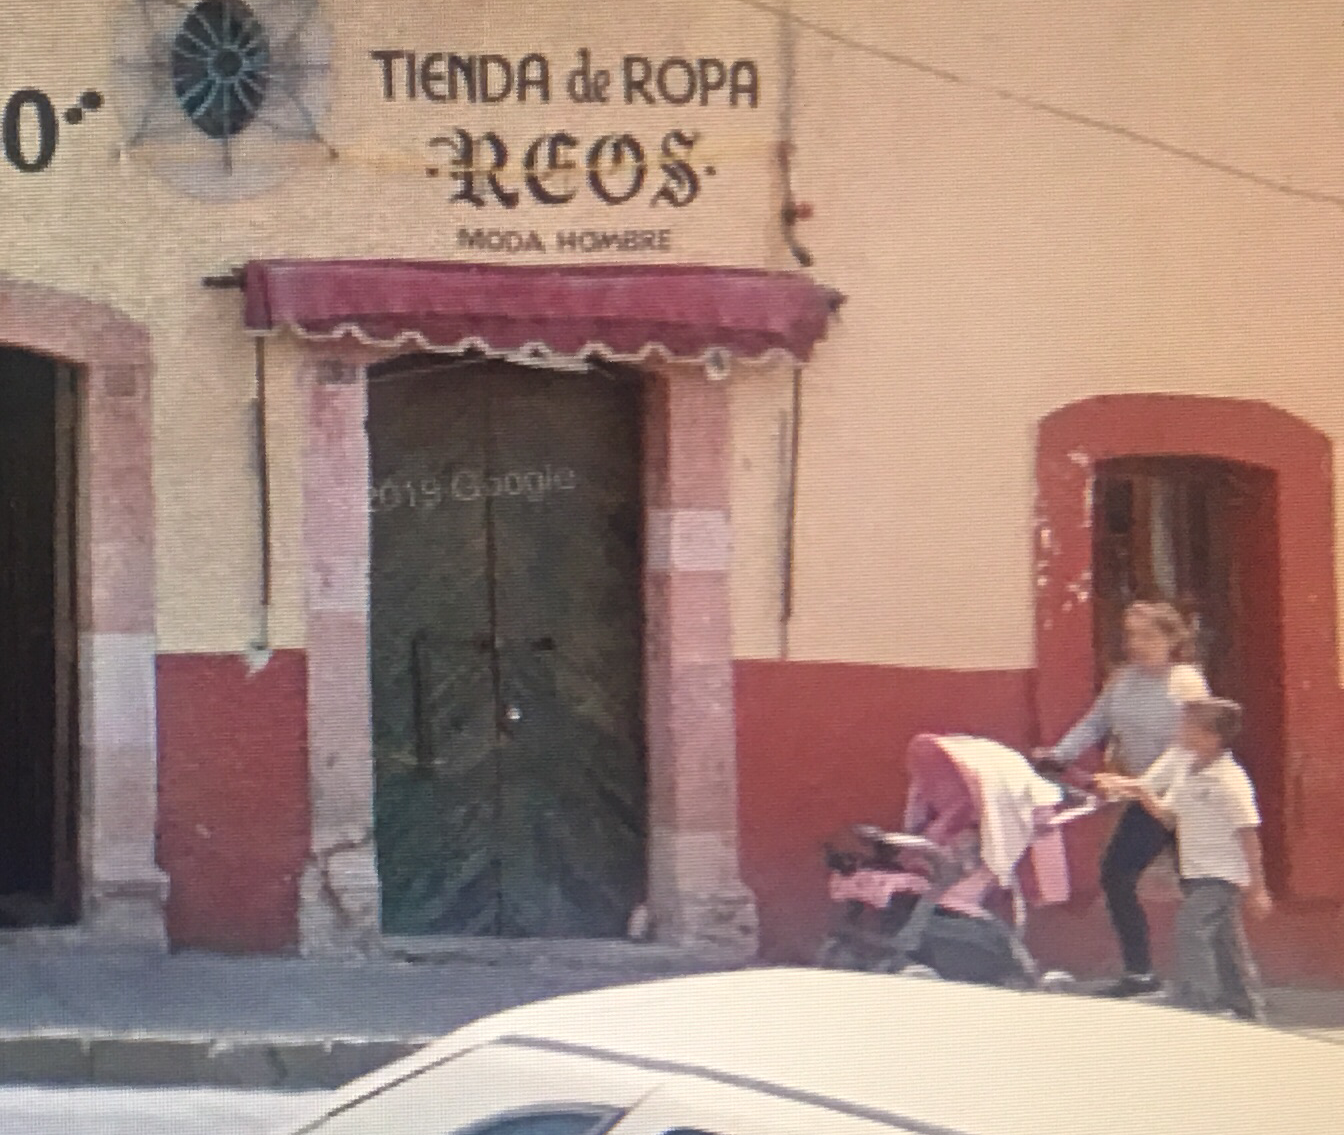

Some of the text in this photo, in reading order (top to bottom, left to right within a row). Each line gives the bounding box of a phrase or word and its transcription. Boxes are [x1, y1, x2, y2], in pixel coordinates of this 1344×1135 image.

[370, 47, 760, 108] TIENDA de ROPA
[458, 227, 672, 254] MODA HOMBRE
